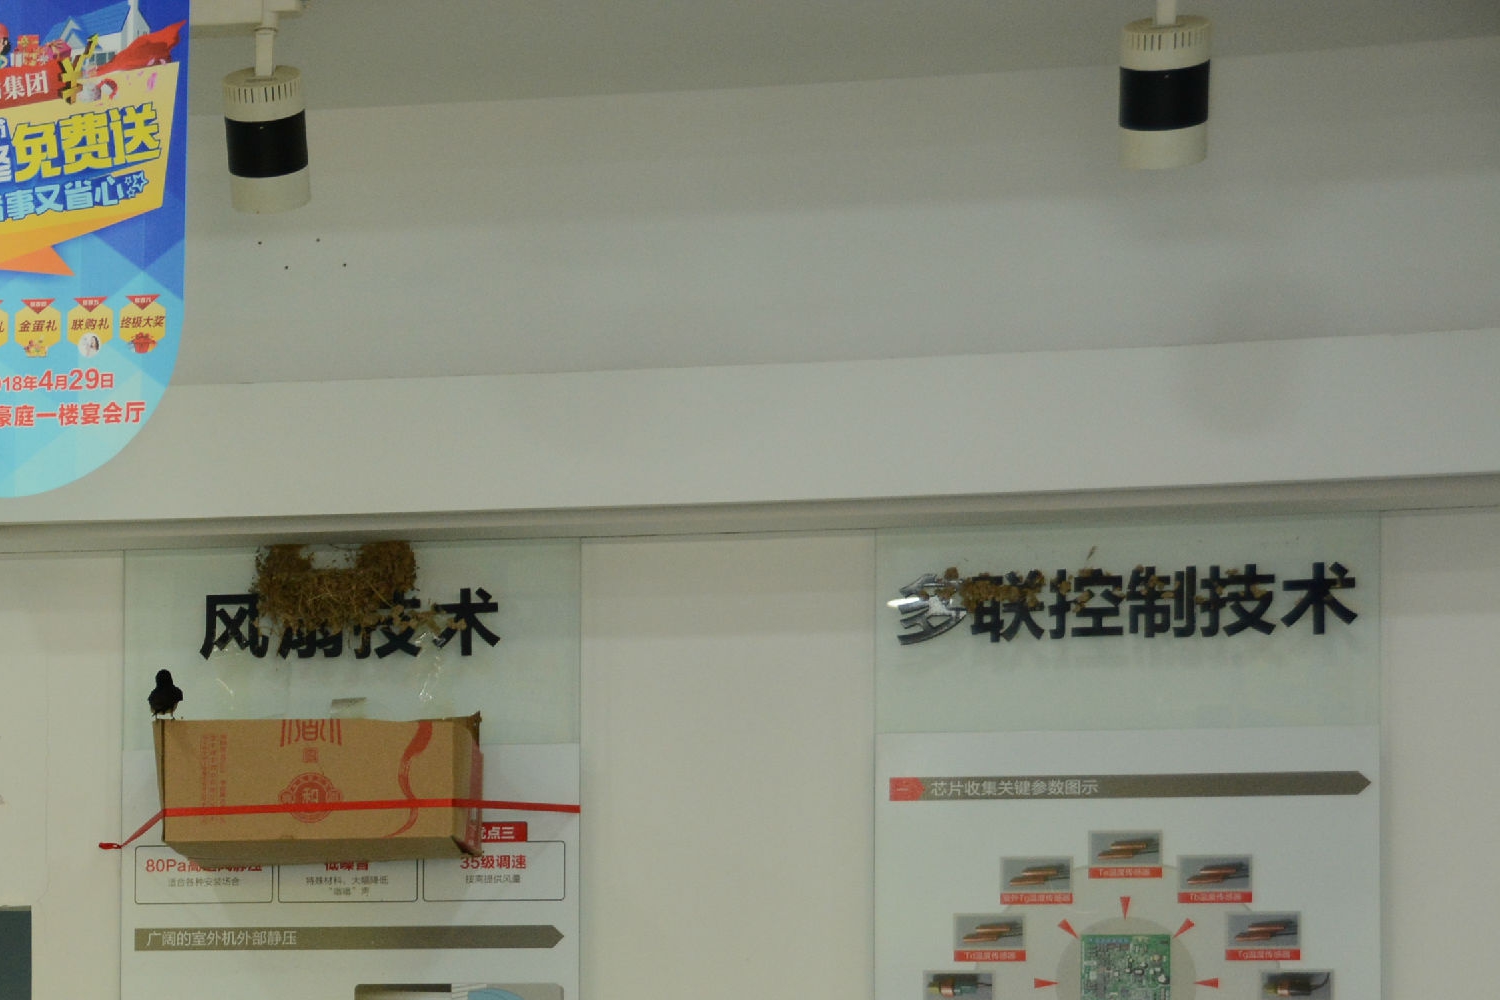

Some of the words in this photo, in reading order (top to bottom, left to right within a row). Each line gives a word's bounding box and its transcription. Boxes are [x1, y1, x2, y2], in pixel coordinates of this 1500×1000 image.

[11, 102, 162, 182] 免费送
[18, 319, 57, 333] 金蛋礼
[70, 317, 110, 331] 联购礼
[120, 315, 166, 329] 终极大奖
[897, 562, 1359, 645] 多联控制技术
[931, 779, 1099, 797] 芯片收集关键参数图示
[460, 855, 527, 869] 35级调速
[146, 930, 297, 947] 广阔的室外机外部静压
